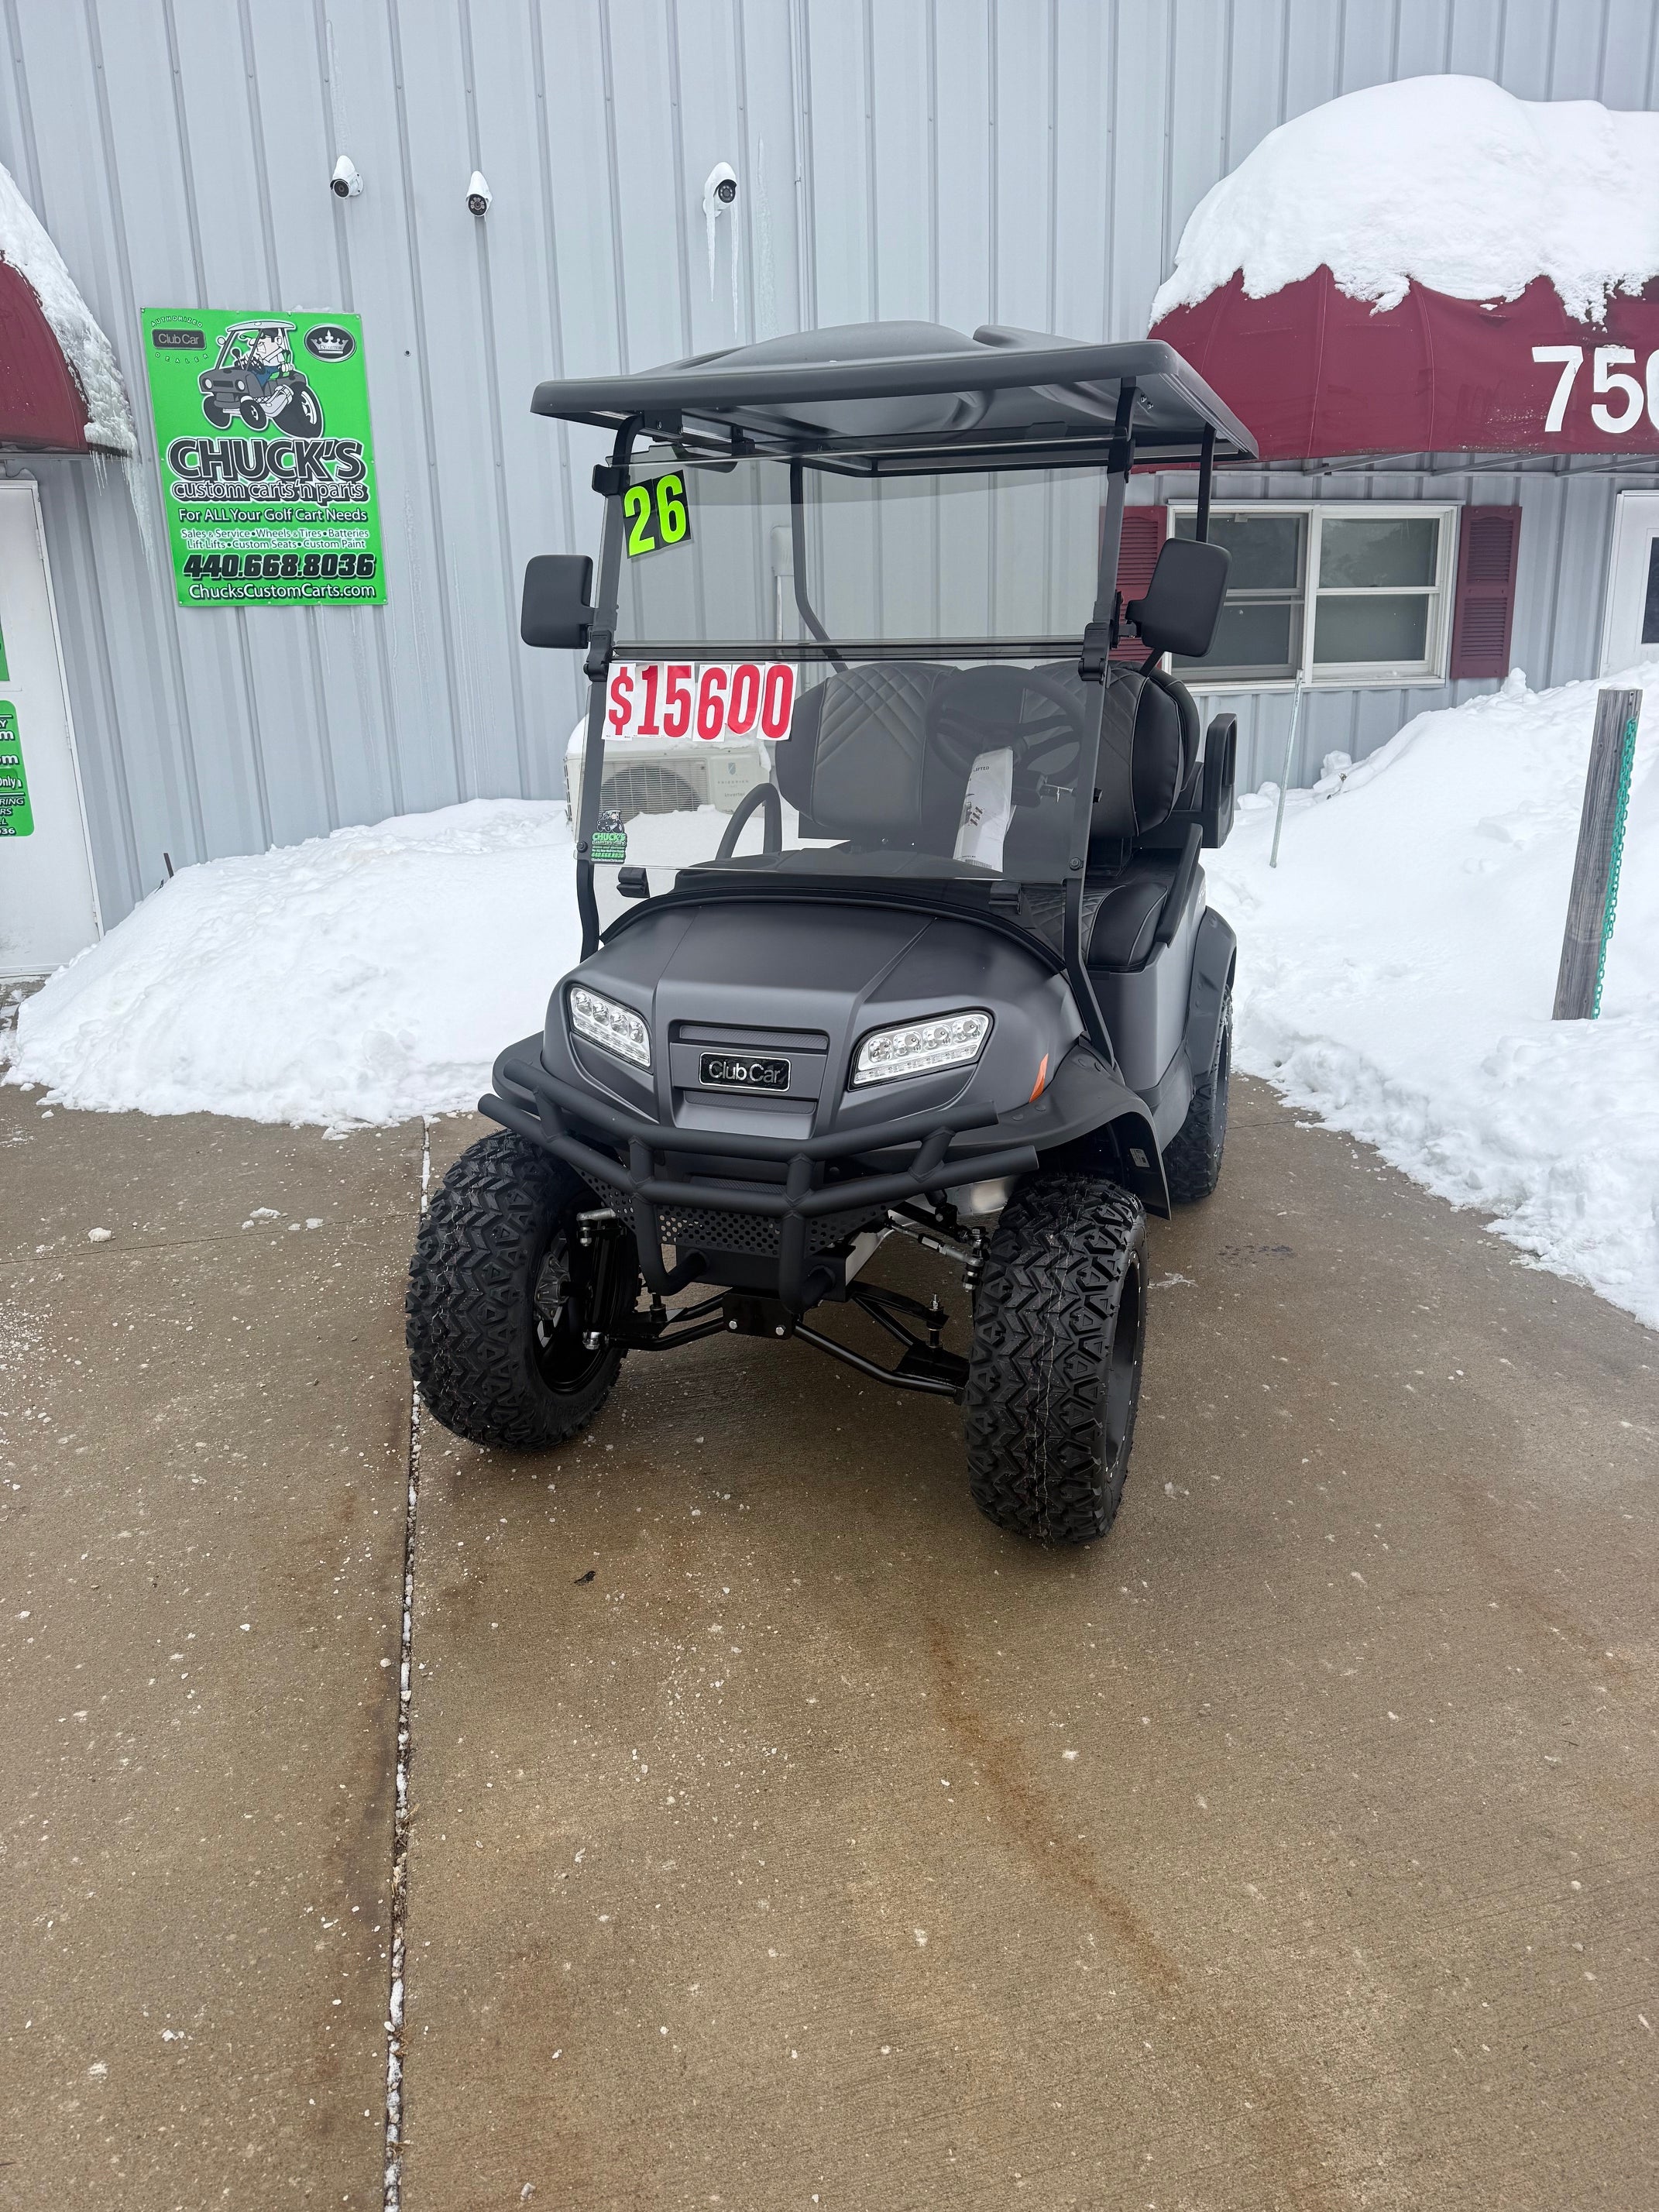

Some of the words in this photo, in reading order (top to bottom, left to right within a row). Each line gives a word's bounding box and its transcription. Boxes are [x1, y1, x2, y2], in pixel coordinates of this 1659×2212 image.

[151, 315, 203, 328] AUTHORIZED
[158, 333, 181, 344] Club
[181, 334, 199, 345] Car
[156, 352, 208, 363] DEALER
[1531, 345, 1659, 434] 75
[168, 438, 366, 482] CHUCK'S
[173, 482, 246, 499] custom
[248, 480, 294, 499] carts
[316, 482, 364, 503] parts
[178, 508, 201, 521] For
[204, 508, 230, 521] ALL
[229, 508, 262, 521] Your
[263, 507, 293, 521] Golf
[295, 508, 324, 521] Cart
[325, 508, 368, 521] Needs
[623, 474, 687, 557] 26
[181, 528, 207, 538] Sales
[215, 528, 250, 538] Service
[256, 528, 291, 538] Wheels
[299, 528, 322, 538] Tires
[328, 528, 369, 538] Batteries
[187, 540, 203, 549] Lift
[205, 540, 225, 549] Lifts
[232, 540, 270, 549] Custom
[271, 539, 297, 549] Seats
[303, 539, 340, 548] Custom
[342, 539, 366, 548] Paint
[183, 553, 376, 579] 440.668.8036
[188, 582, 376, 599] ChucksCustomCarts.com
[608, 664, 794, 740] $15600
[709, 1060, 747, 1080] Club
[749, 1063, 781, 1084] Car
